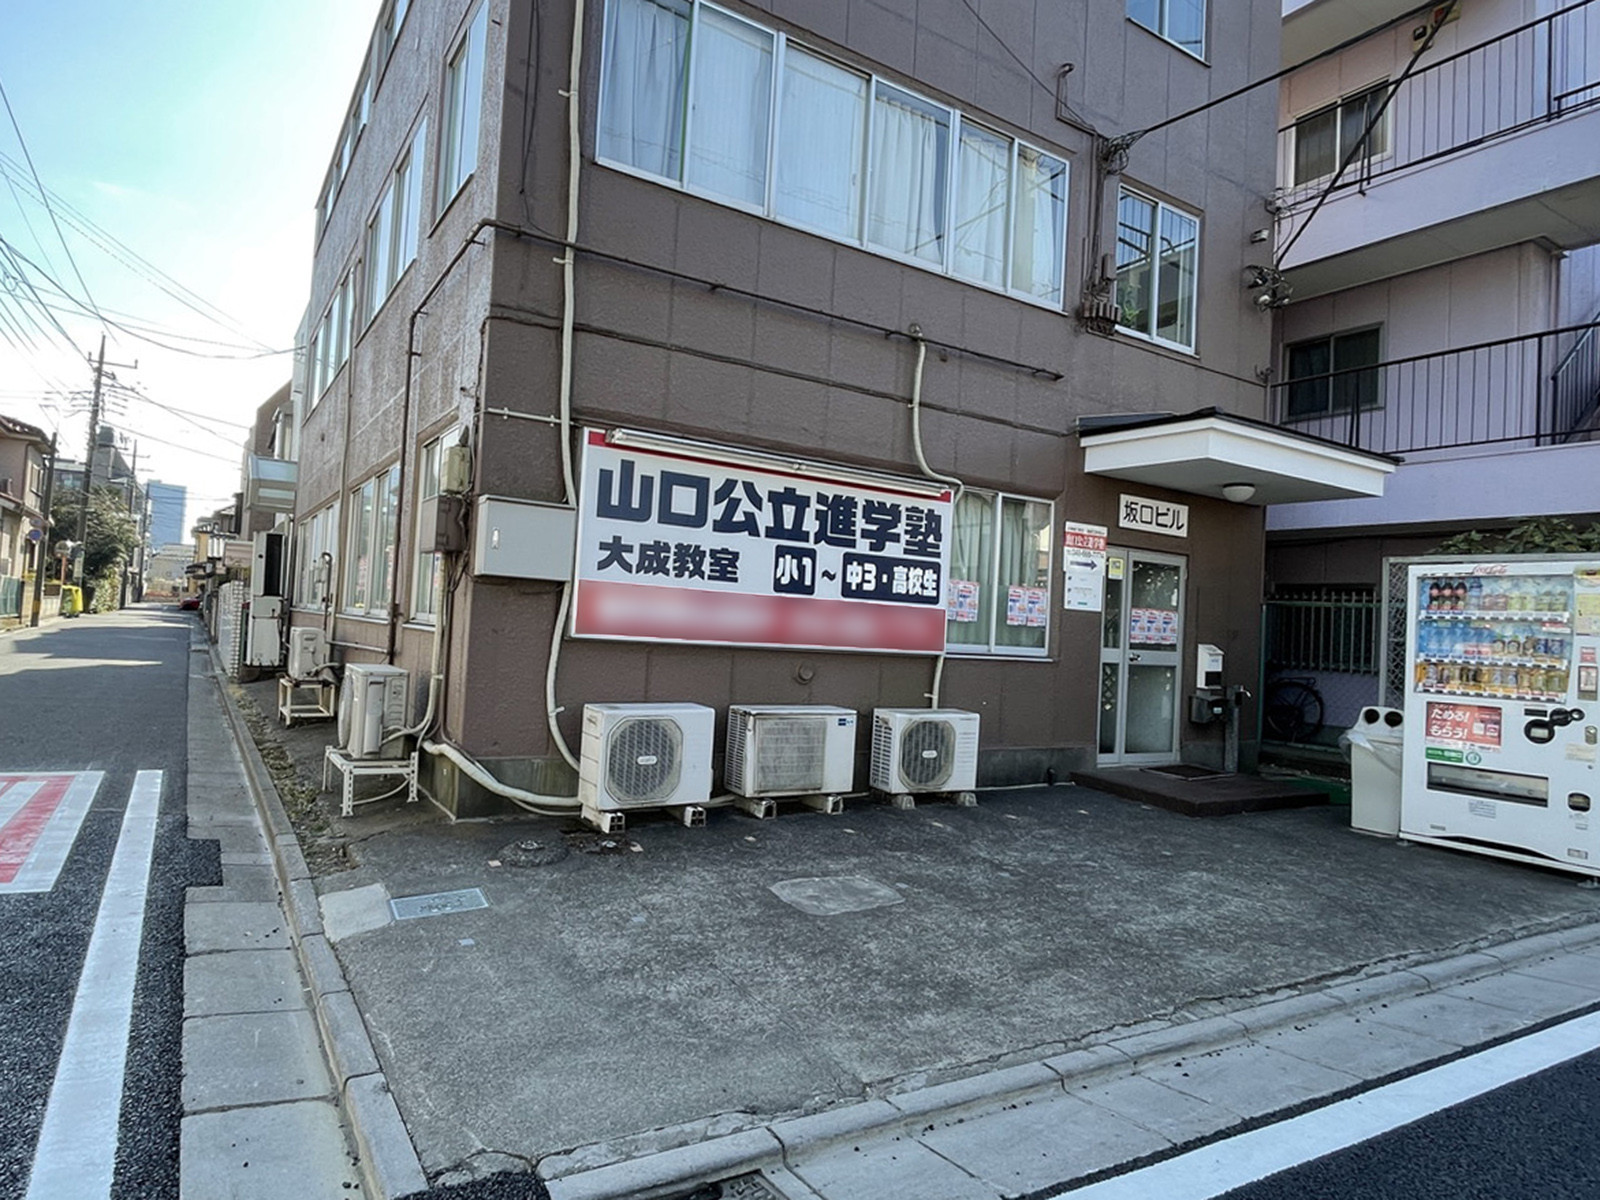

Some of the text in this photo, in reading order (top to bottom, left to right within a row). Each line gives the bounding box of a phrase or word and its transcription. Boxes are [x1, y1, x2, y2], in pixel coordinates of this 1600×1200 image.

[597, 459, 942, 558] 山口公立進学塾
[1123, 500, 1185, 530] 坂口ビル
[597, 536, 739, 583] 大成教室
